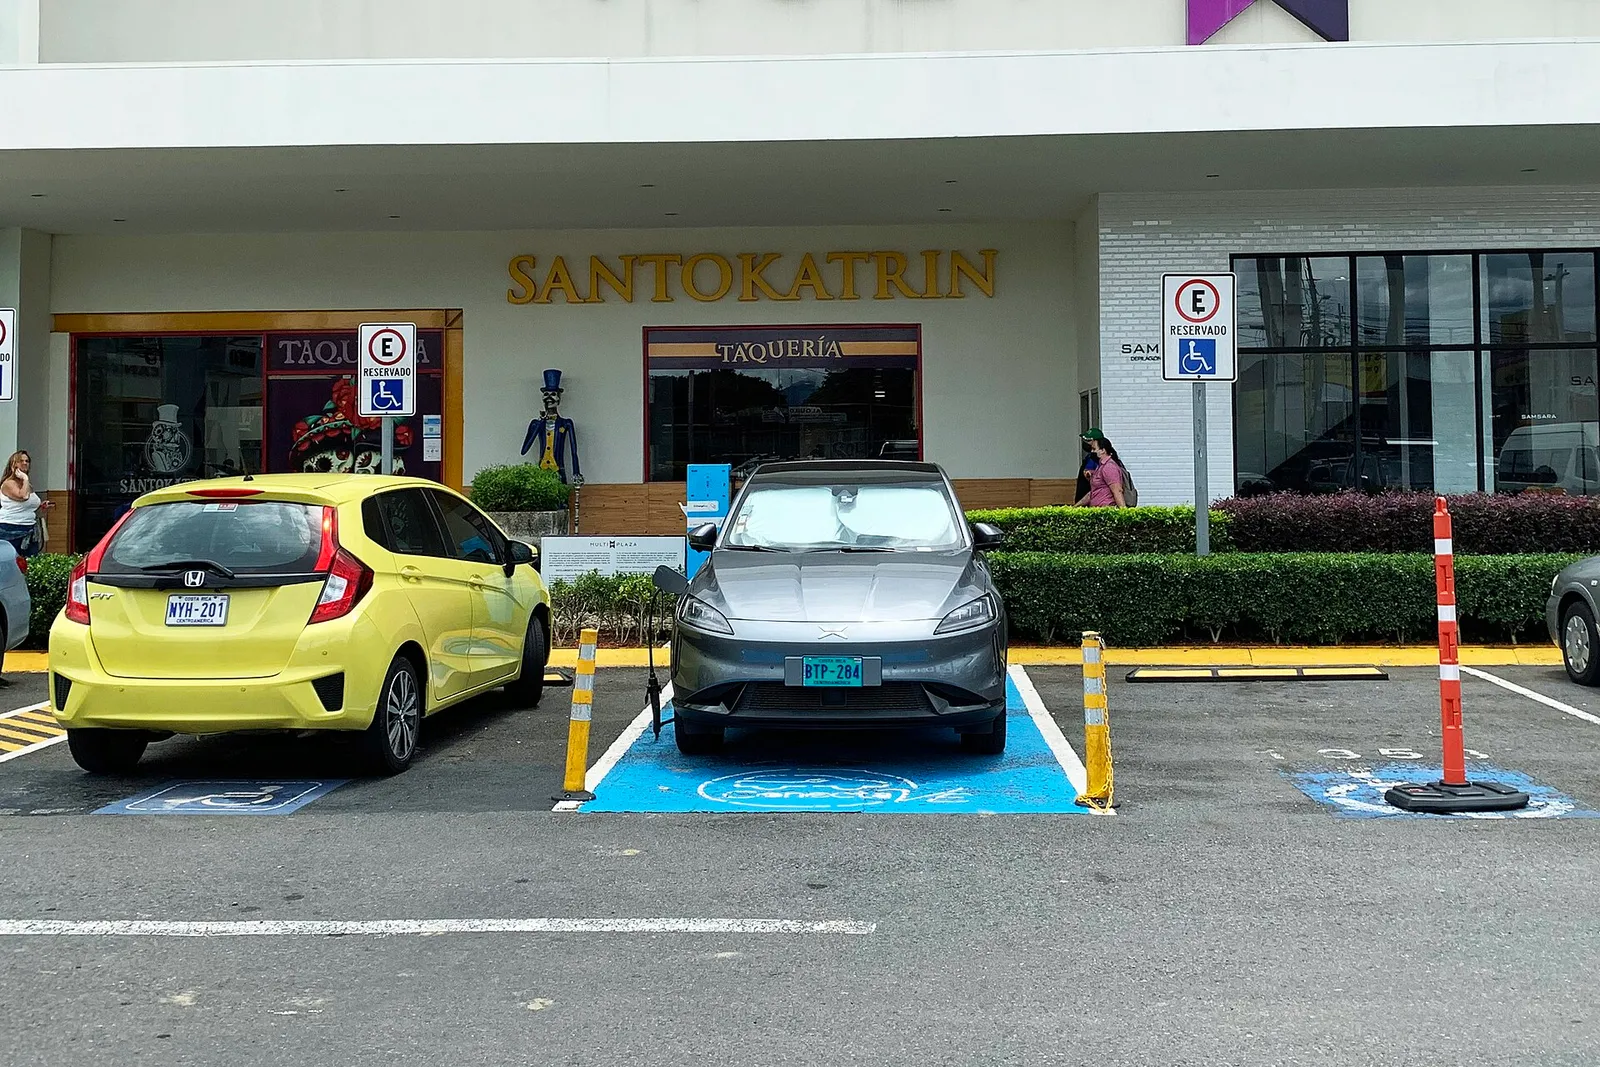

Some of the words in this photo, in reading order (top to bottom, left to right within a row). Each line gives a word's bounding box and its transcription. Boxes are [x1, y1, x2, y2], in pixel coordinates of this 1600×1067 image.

[507, 249, 998, 305] SANTOKATRIN
[1192, 290, 1205, 312] E
[1170, 325, 1227, 336] RESERVADO
[278, 338, 431, 366] TAQUA
[381, 338, 393, 357] E
[718, 335, 842, 364] TAQUERÍA
[363, 367, 411, 378] RESERVADO
[91, 592, 114, 600] FIT
[169, 602, 224, 618] NYH-201
[805, 664, 860, 679] BTP-284
